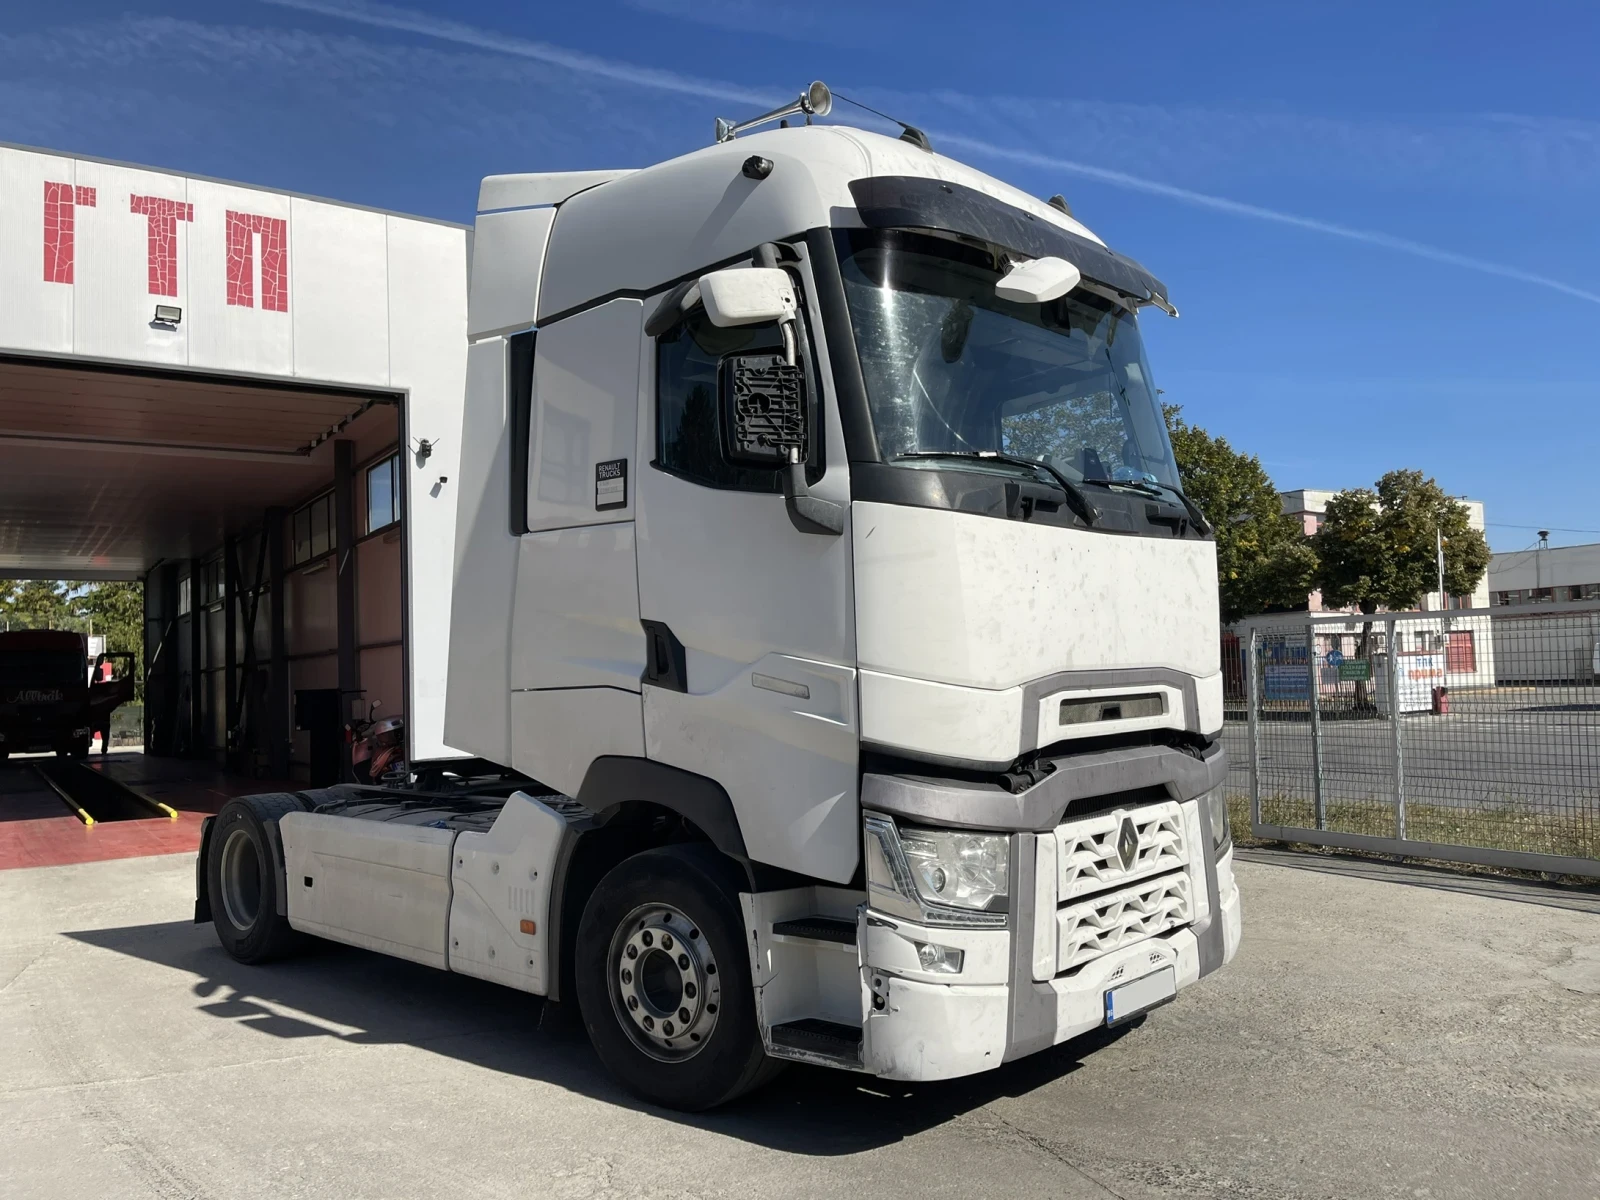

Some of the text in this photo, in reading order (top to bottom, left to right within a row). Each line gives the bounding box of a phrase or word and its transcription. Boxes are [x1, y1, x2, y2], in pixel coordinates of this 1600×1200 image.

[43, 180, 289, 313] ГТП
[598, 463, 621, 472] RENAULT
[599, 469, 621, 479] TRUCKS
